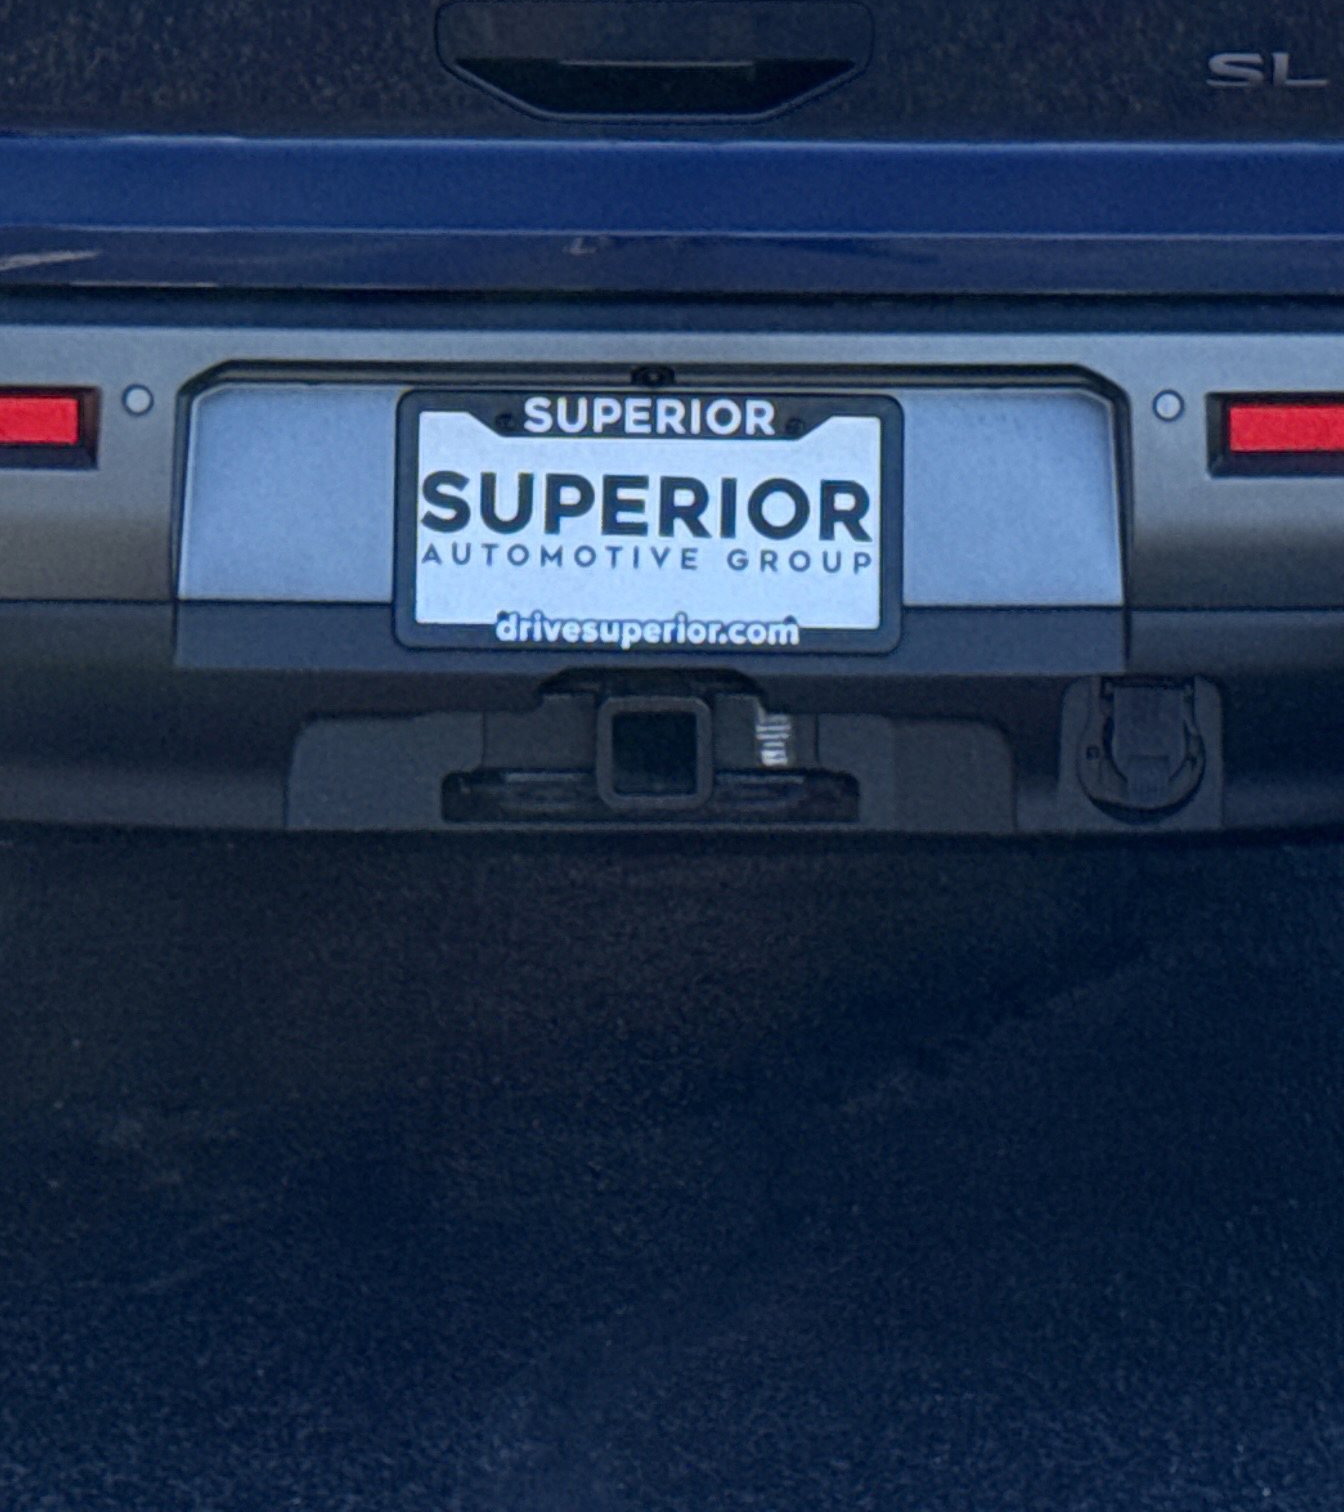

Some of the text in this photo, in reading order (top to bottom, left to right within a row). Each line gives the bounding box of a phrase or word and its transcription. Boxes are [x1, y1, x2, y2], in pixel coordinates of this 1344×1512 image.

[1206, 51, 1329, 87] SL
[523, 396, 776, 436] SUPERIOR
[419, 470, 873, 542] SUPERIOR
[421, 542, 873, 574] AUTOMOTIVE GROUP
[495, 610, 800, 650] drivesuperior.com
